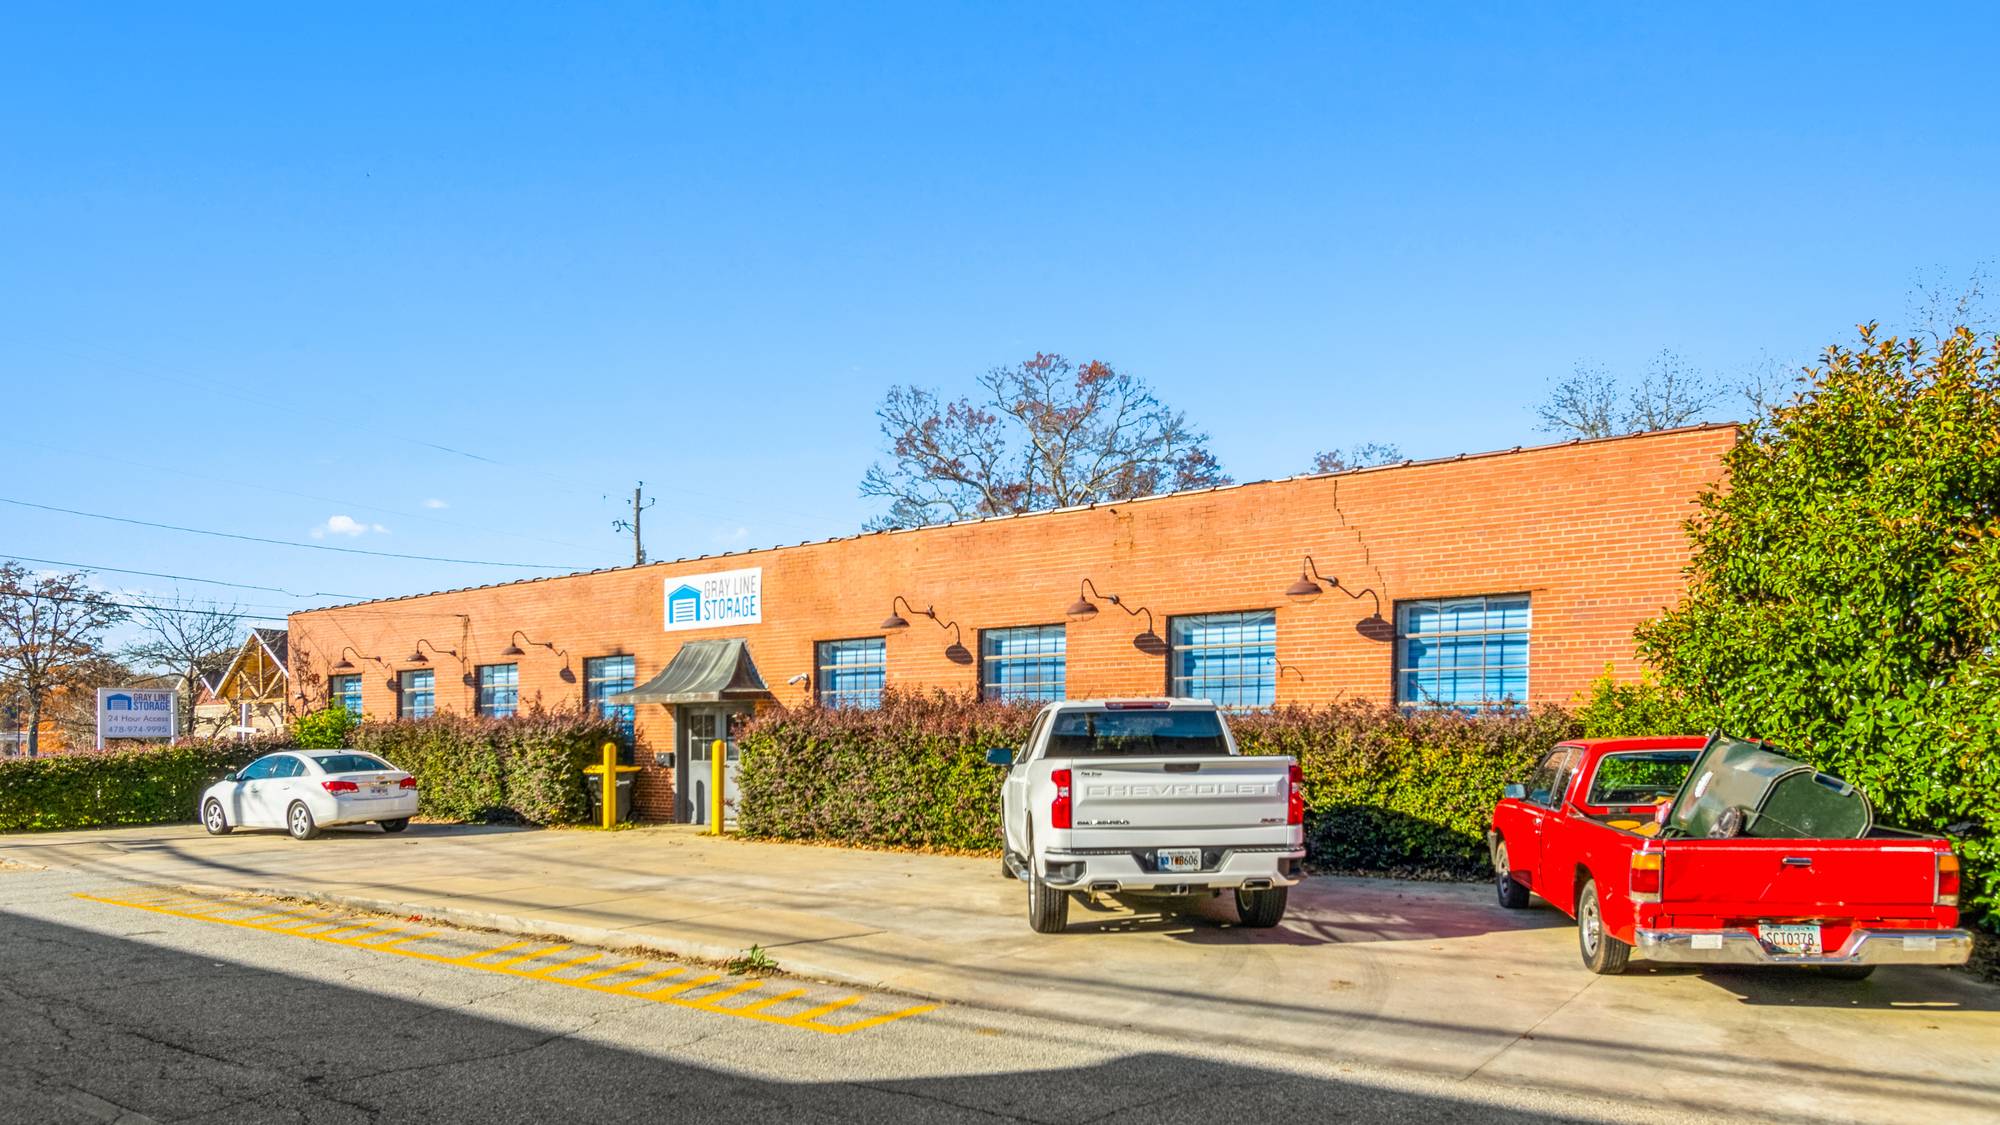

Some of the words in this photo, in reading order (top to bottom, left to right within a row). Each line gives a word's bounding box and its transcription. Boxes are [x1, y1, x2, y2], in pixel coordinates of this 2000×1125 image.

[704, 578, 730, 599] GRAY
[734, 575, 756, 595] LINE
[704, 595, 756, 621] STORAGE
[133, 693, 151, 701] GRAY
[154, 693, 170, 701] LINE
[133, 701, 170, 711] STORAGE
[1086, 783, 1276, 798] CHEVROLET
[1766, 932, 1815, 946] SCT0378
